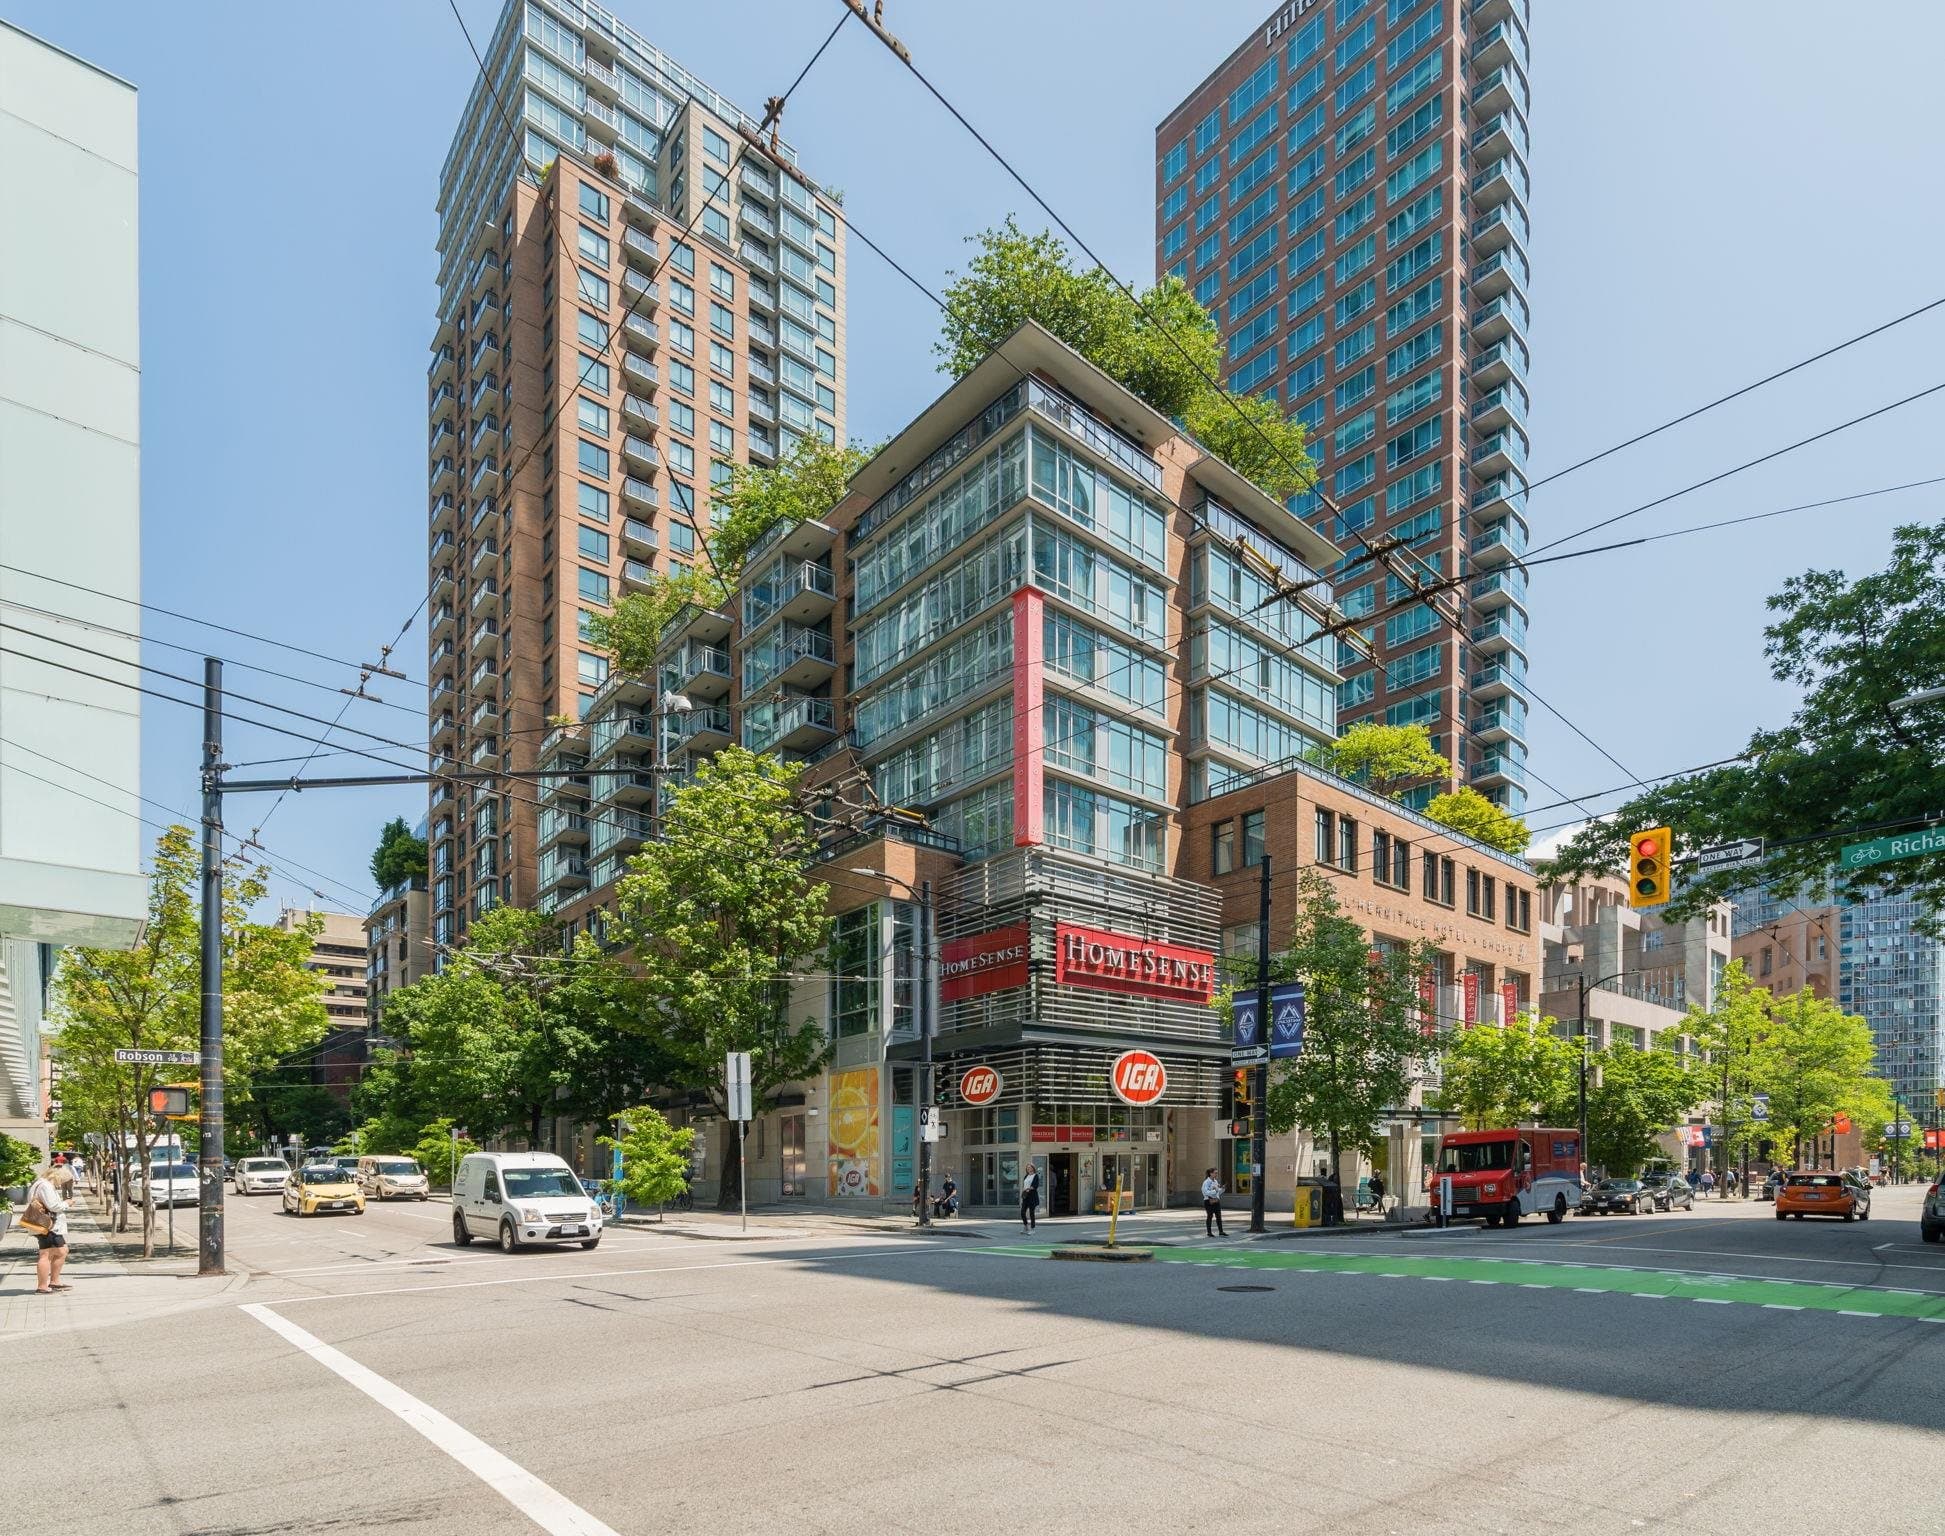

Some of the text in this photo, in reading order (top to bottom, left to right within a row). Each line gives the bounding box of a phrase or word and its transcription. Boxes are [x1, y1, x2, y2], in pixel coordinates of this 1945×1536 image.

[1703, 847, 1744, 862] ONE WAY
[119, 1051, 163, 1061] Robson
[964, 1073, 994, 1095] IGA
[1120, 1062, 1159, 1091] IGA
